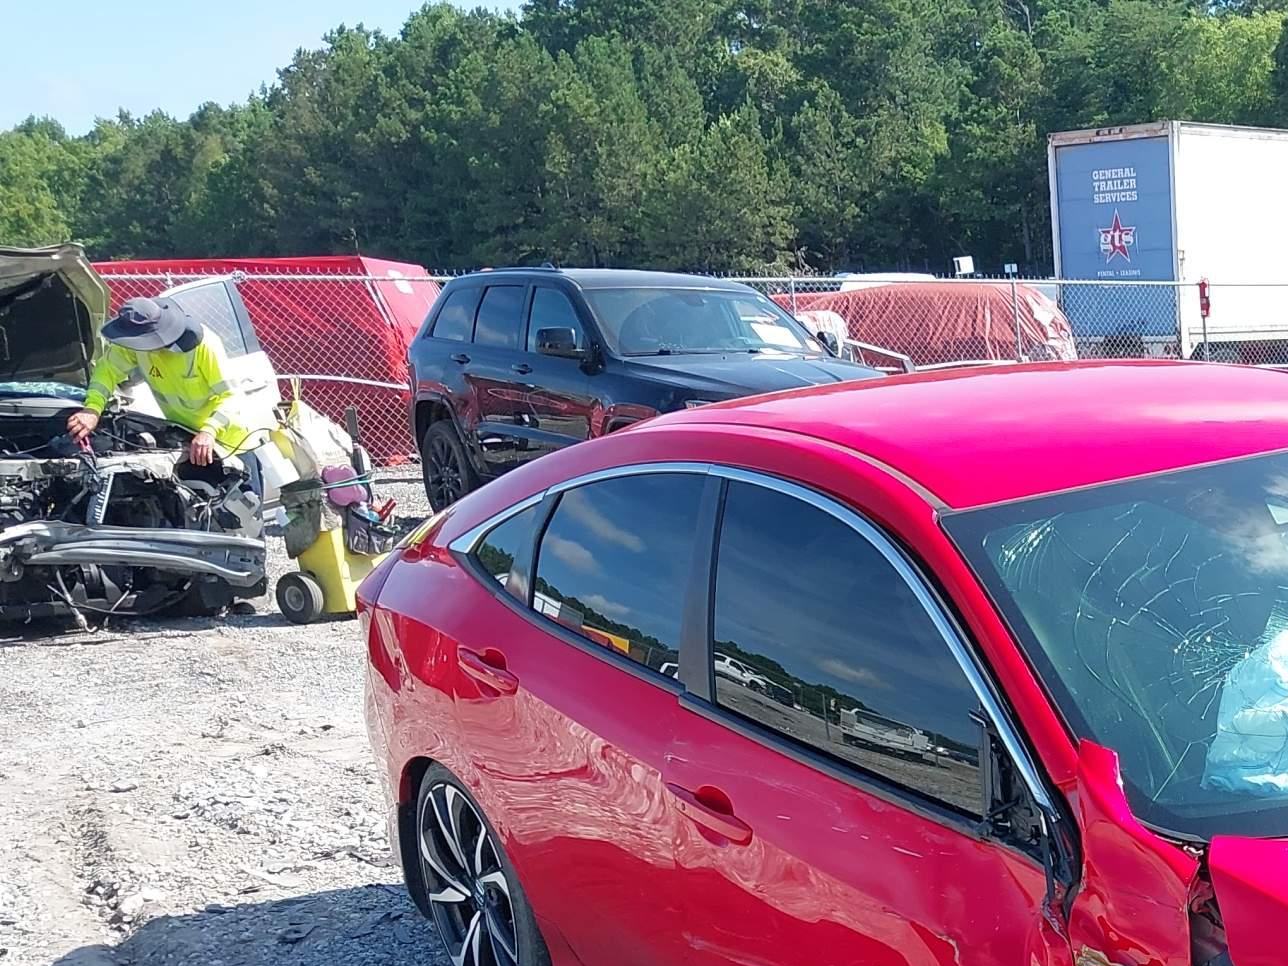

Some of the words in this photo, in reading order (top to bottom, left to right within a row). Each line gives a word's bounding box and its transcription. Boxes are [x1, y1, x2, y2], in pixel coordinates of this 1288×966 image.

[1092, 167, 1136, 180] GENERAL
[1093, 178, 1136, 192] TRAILER
[1093, 191, 1138, 204] SERVICES
[1100, 229, 1134, 254] gts
